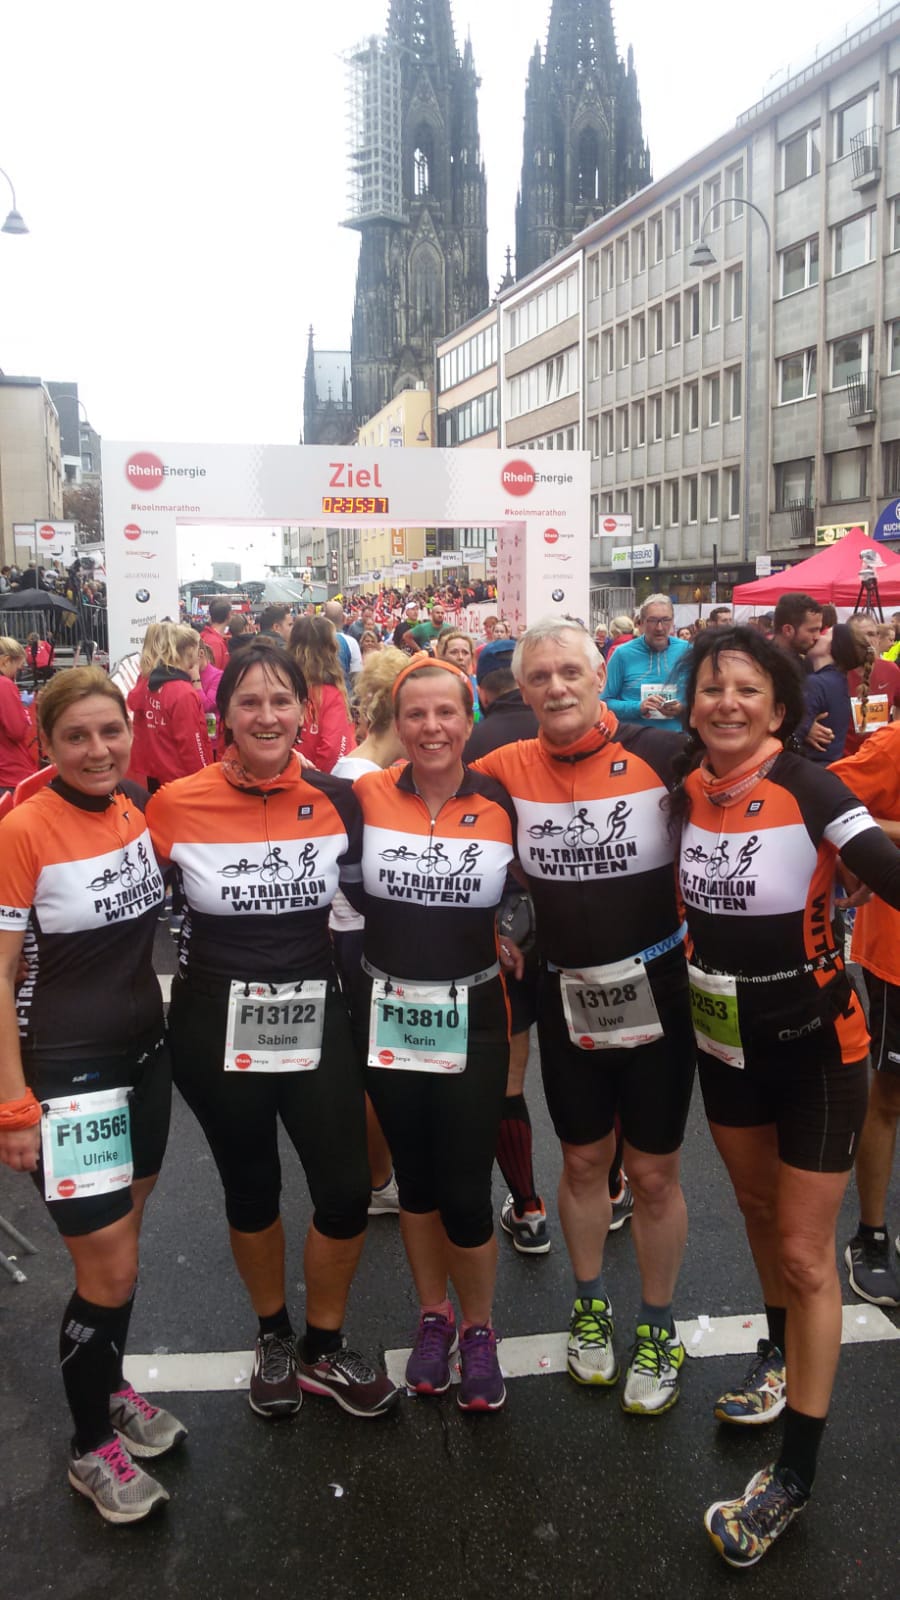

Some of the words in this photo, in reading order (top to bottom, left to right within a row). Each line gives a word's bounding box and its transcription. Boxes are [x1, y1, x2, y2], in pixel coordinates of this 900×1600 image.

[128, 464, 207, 479] RheinEnergie
[329, 463, 382, 488] Ziel
[503, 471, 573, 485] RheinEnergie
[130, 504, 201, 512] #koelnmarathon
[322, 498, 387, 513] 02:35:37
[504, 508, 567, 517] #koelnmarathon
[529, 841, 638, 863] PV-TRIATHLON
[538, 859, 628, 876] WITTEN
[379, 868, 481, 892] PV-TRIATHLON
[221, 879, 327, 901] PV-TRIATHLON
[387, 884, 471, 904] WITTEN
[683, 886, 747, 911] WITTEN
[105, 888, 162, 922] WITTEN
[231, 895, 319, 912] WITTEN
[575, 983, 638, 1009] 13128
[240, 1003, 316, 1025] F13122
[382, 1004, 460, 1029] F13810
[597, 1015, 625, 1027] Uwe
[257, 1034, 298, 1046] Sabine
[404, 1033, 436, 1047] Karin
[56, 1114, 128, 1147] F13565
[83, 1150, 119, 1166] Ulrike
